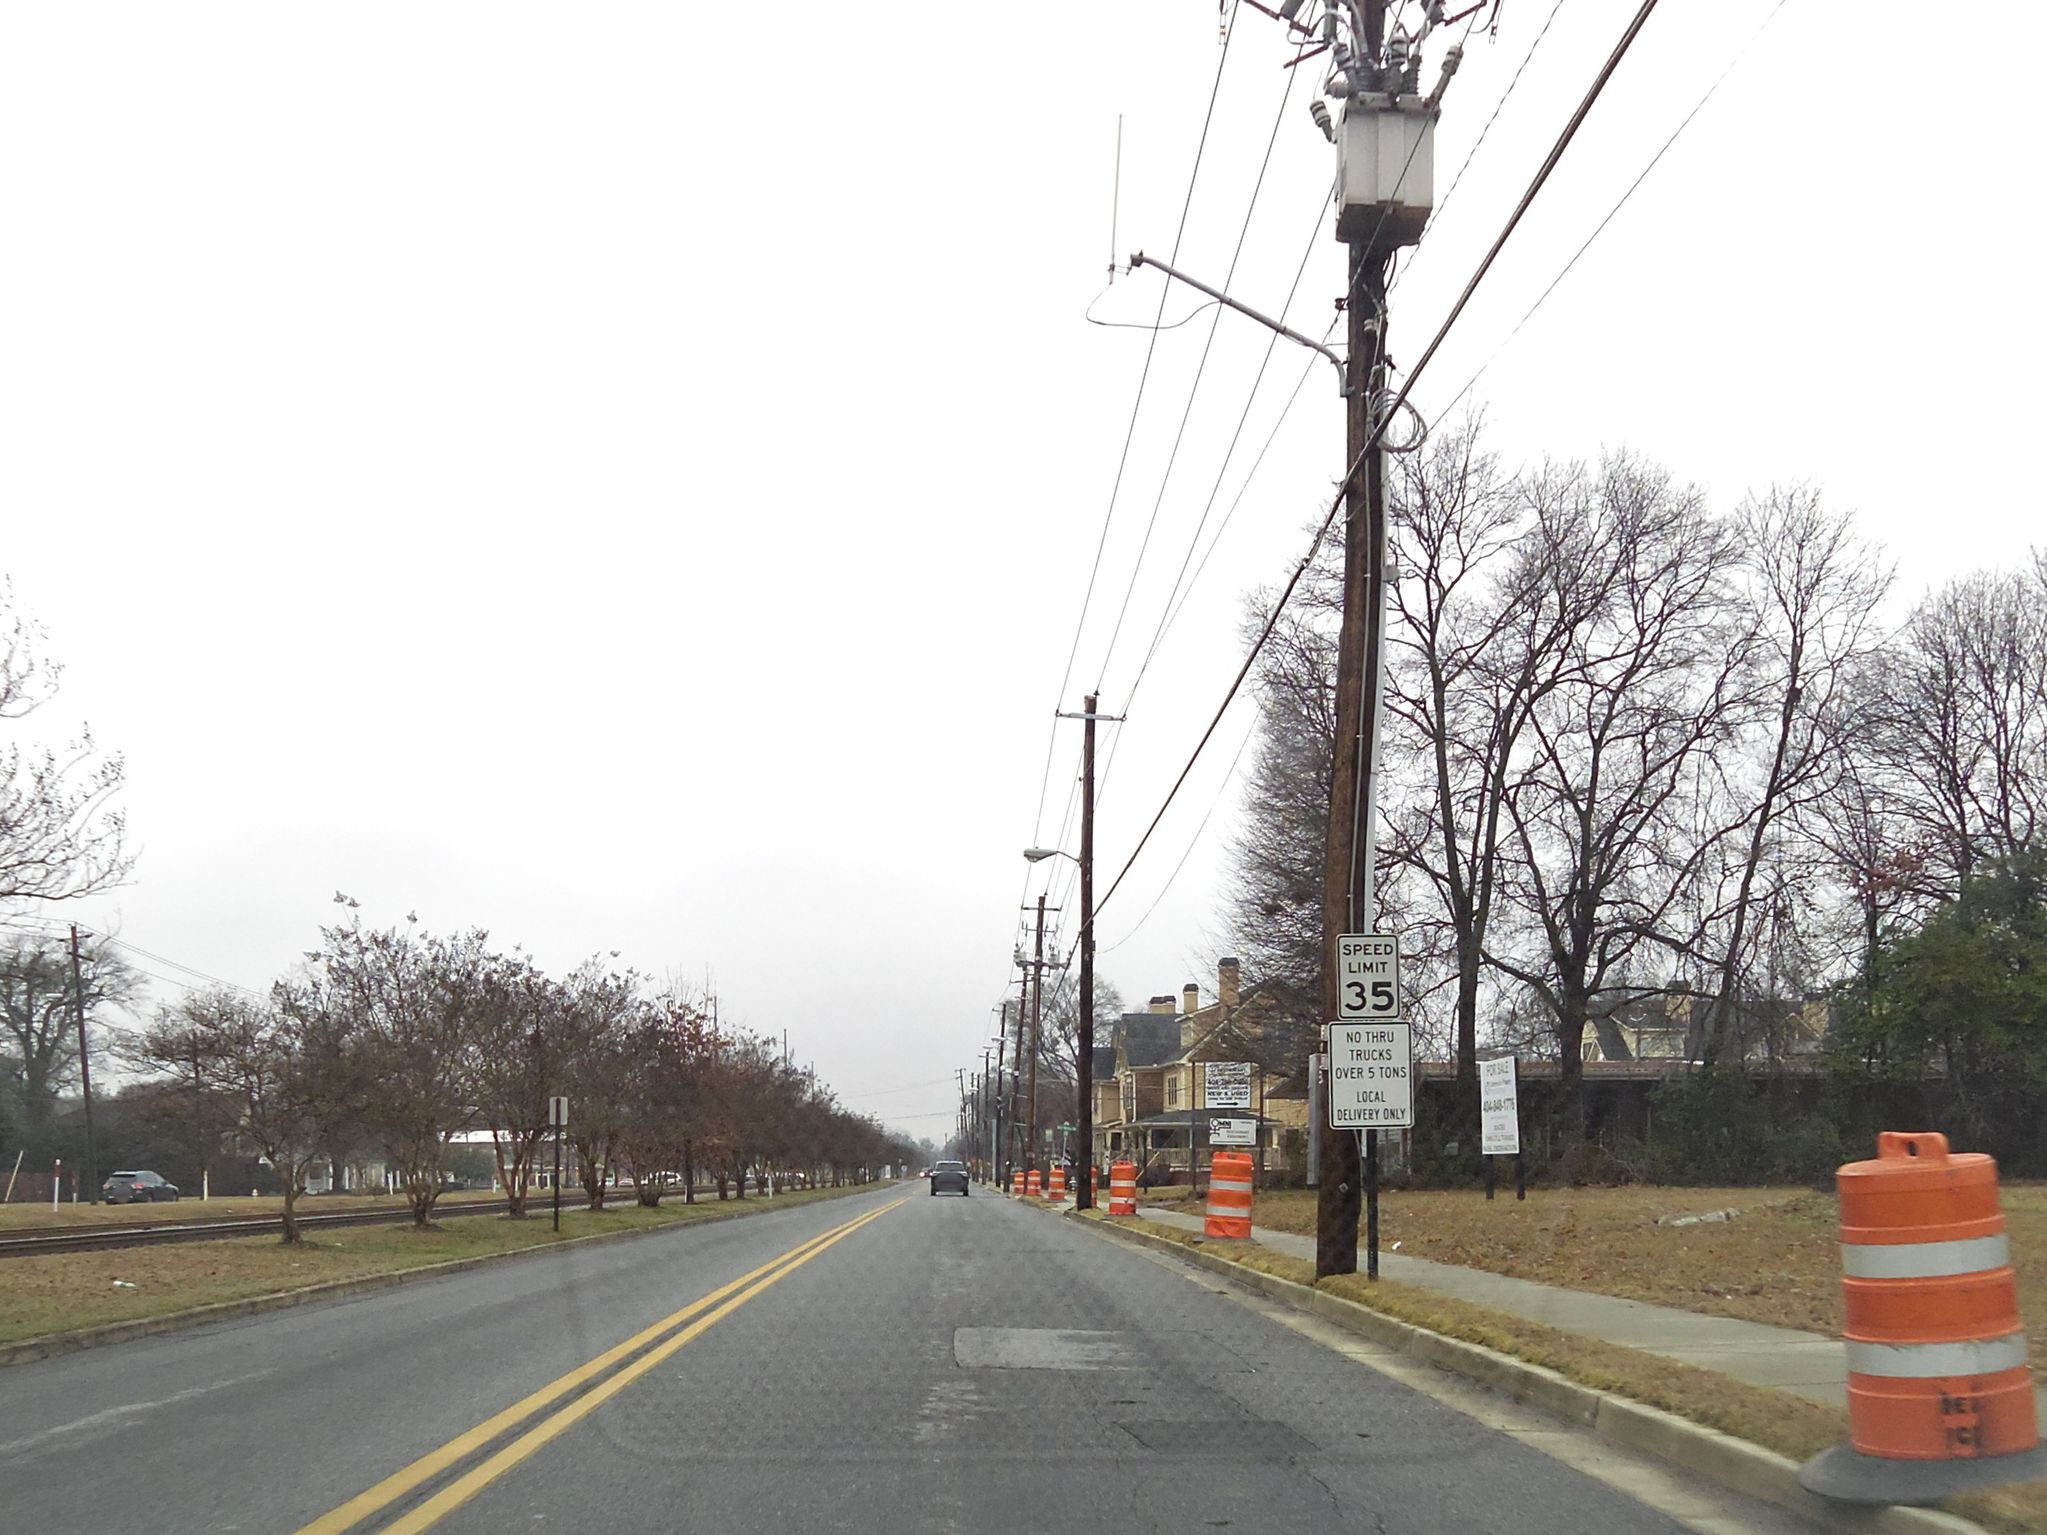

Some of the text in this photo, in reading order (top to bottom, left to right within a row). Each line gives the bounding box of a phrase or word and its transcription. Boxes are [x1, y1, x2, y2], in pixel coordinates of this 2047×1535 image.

[1342, 943, 1394, 956] SPEED
[1348, 961, 1388, 974] LIMIT
[1345, 981, 1395, 1012] 35
[1346, 1031, 1394, 1043] NO THRU
[1349, 1049, 1392, 1061] TRUCKS
[1335, 1066, 1407, 1080] OVER 5 TONS
[1356, 1091, 1386, 1103] LOCAL
[1337, 1108, 1406, 1121] DELIVERY ONLY
